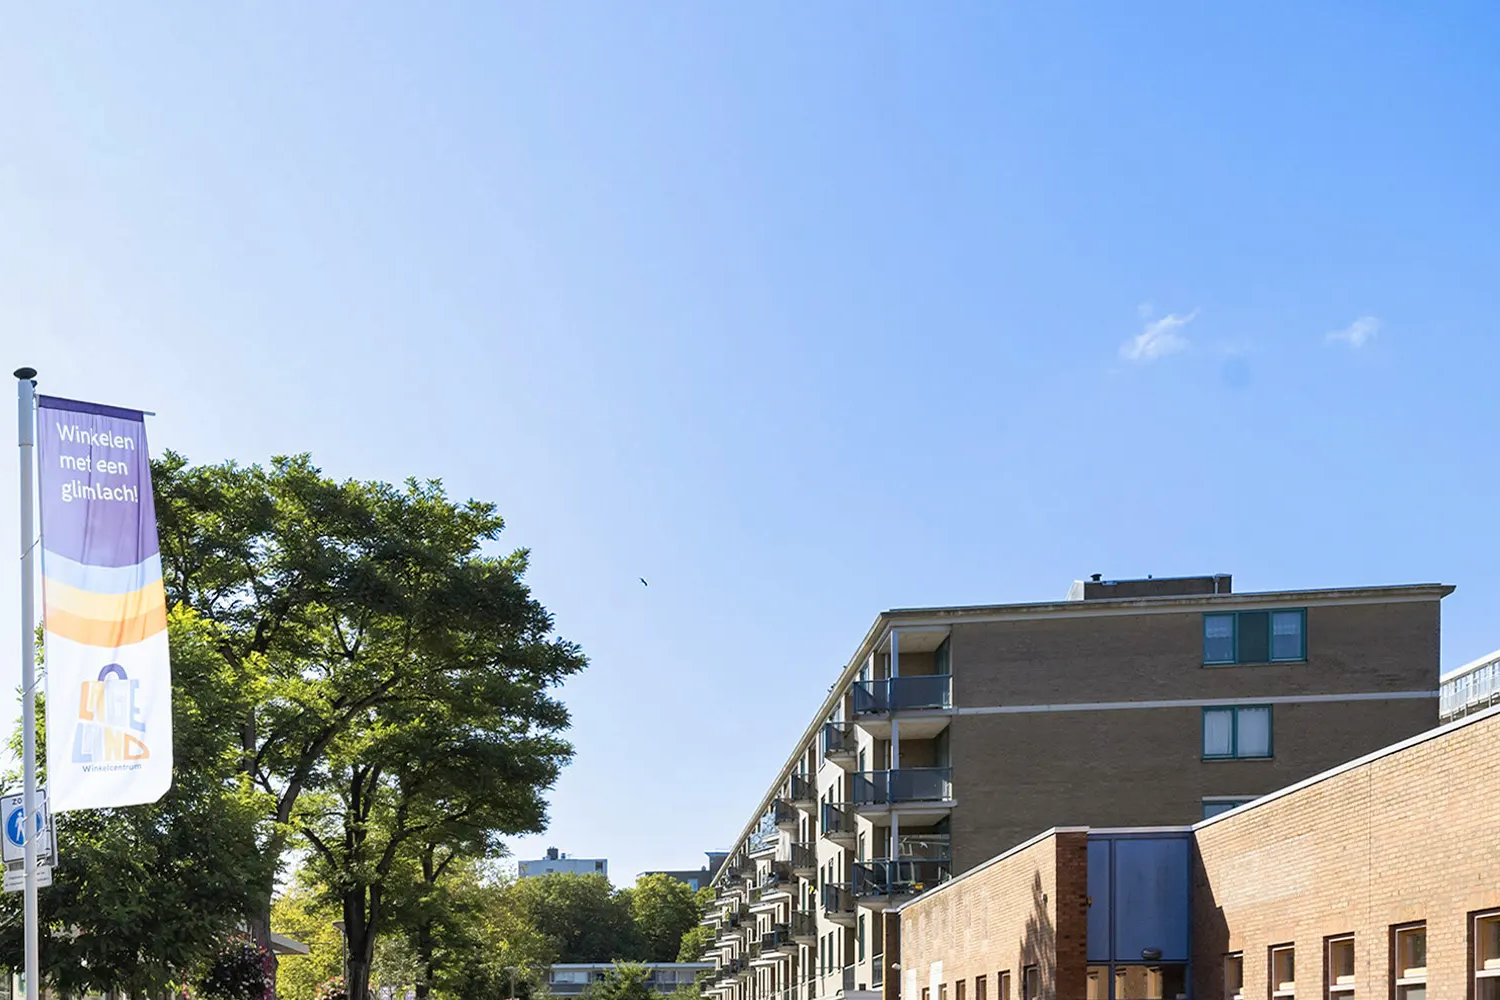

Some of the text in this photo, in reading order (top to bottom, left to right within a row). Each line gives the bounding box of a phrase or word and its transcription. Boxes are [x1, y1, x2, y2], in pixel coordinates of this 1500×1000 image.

[57, 422, 135, 450] Winkelen
[60, 455, 129, 476] met een
[61, 479, 139, 503] glimlach!
[82, 763, 142, 773] Winkelcentrum
